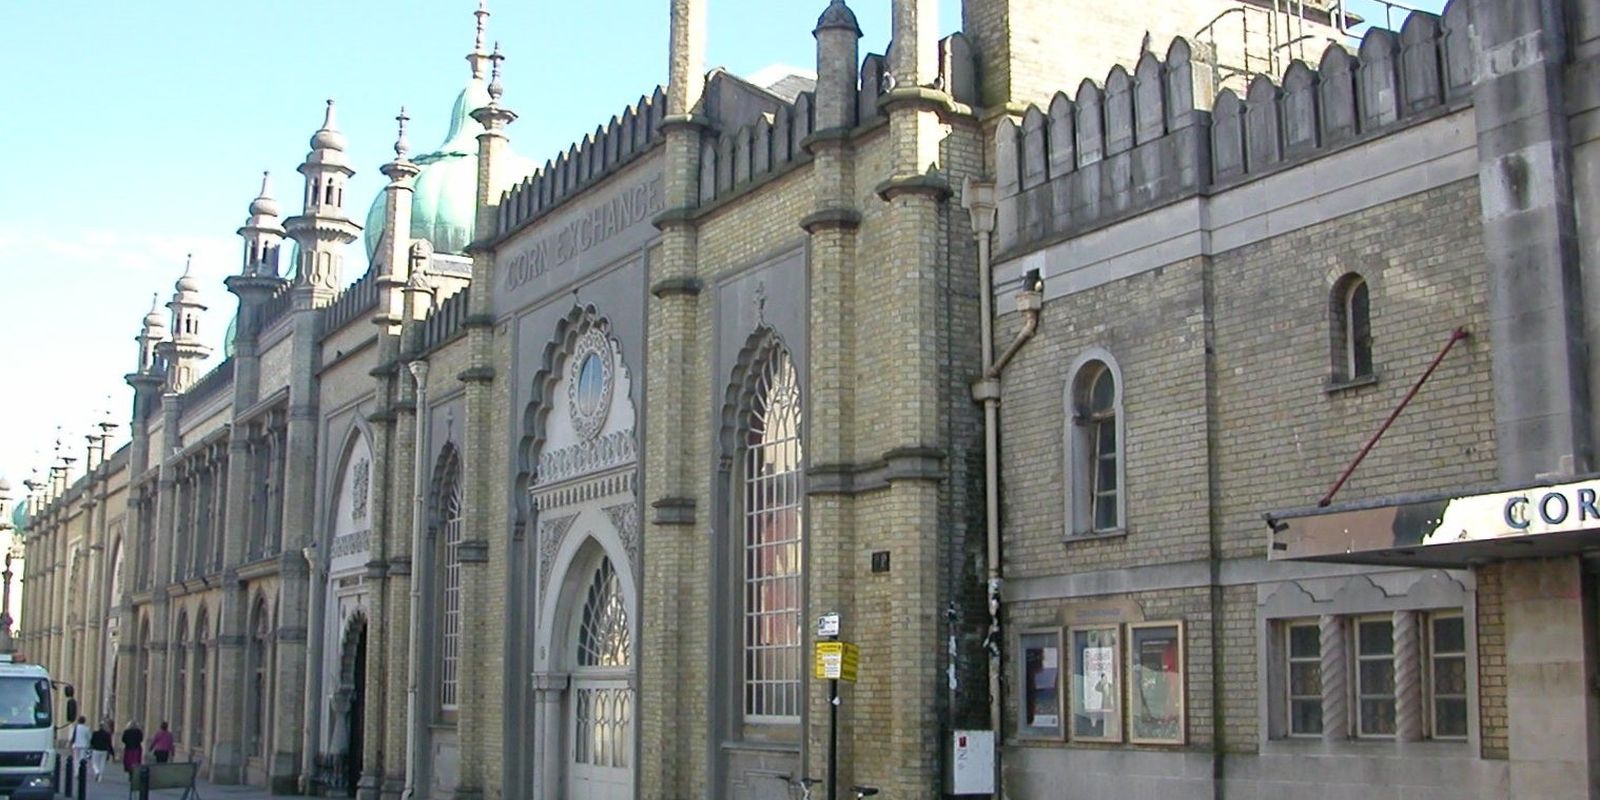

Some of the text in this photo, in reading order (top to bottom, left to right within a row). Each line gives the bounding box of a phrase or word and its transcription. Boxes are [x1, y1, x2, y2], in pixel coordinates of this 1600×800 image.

[506, 172, 665, 292] CORN EXCHANGE
[1504, 488, 1600, 529] COR
